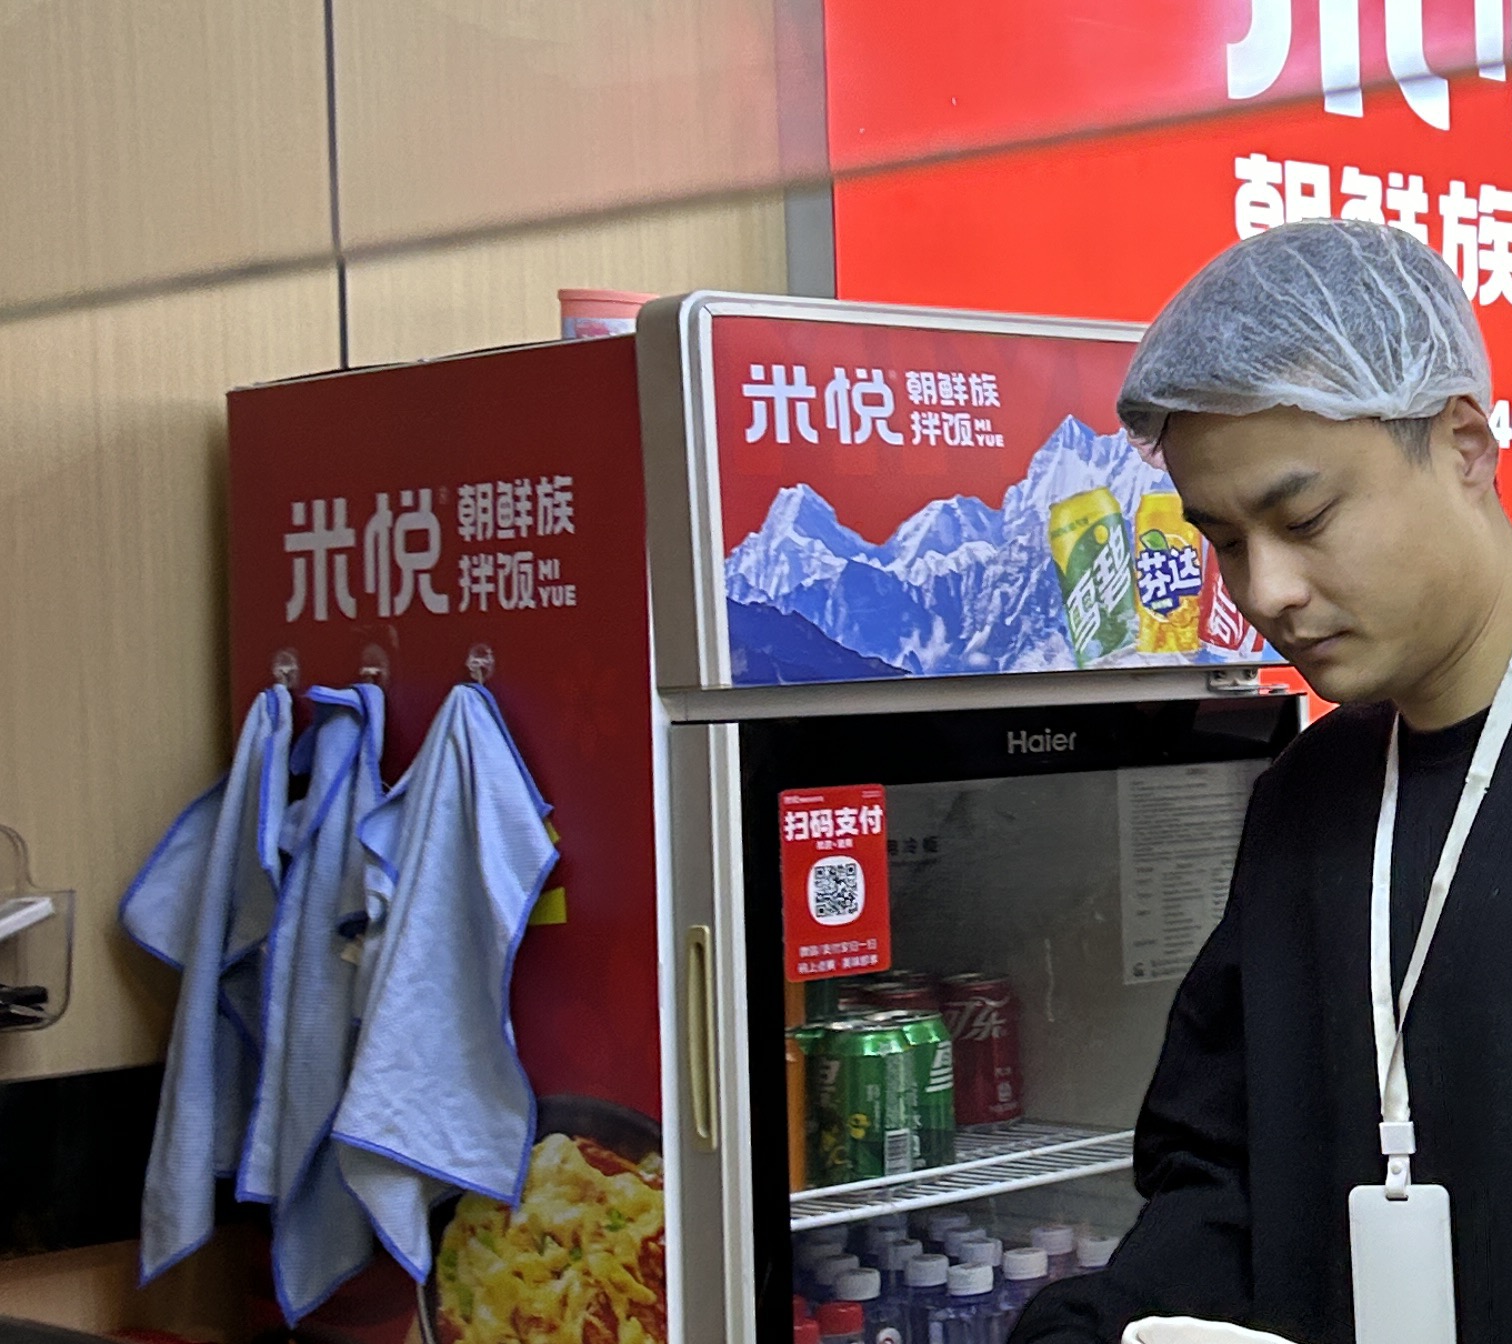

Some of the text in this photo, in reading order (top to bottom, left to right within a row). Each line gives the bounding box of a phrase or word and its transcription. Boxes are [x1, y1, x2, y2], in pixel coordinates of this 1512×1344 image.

[742, 364, 1001, 445] 米悦 朝鲜族
[911, 410, 975, 447] 拌饭
[975, 433, 1005, 448] YUE
[284, 475, 576, 623] 米悦 朝鲜族
[457, 550, 538, 612] 拌饭
[538, 558, 561, 581] MI
[1136, 547, 1201, 604] 芬达
[537, 584, 577, 607] YUE
[1007, 728, 1077, 754] Haier
[784, 804, 883, 842] 扫码支付
